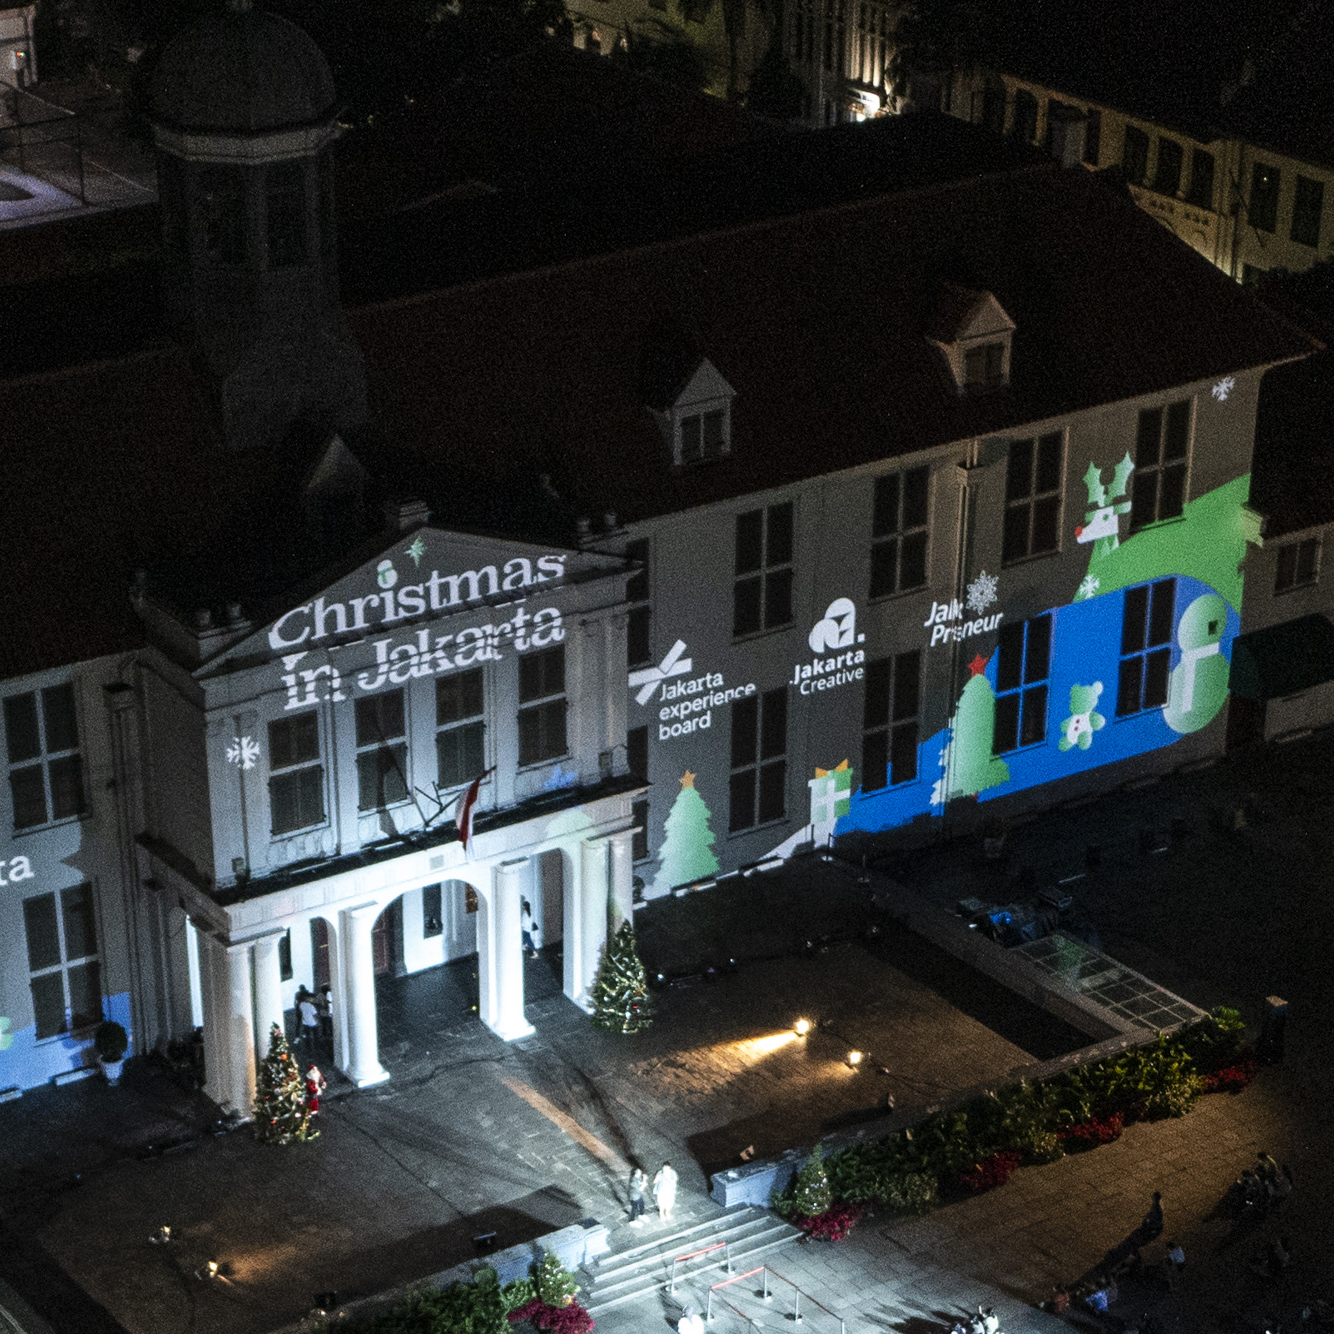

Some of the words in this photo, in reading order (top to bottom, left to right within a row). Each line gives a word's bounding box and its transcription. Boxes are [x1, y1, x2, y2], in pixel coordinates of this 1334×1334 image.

[268, 554, 566, 650] Christmas
[358, 606, 565, 691] Jakarta
[789, 649, 865, 685] Jakarta
[800, 667, 864, 695] Creative
[659, 672, 724, 702] Jakarta
[659, 683, 756, 720] experience
[659, 710, 711, 740] board
